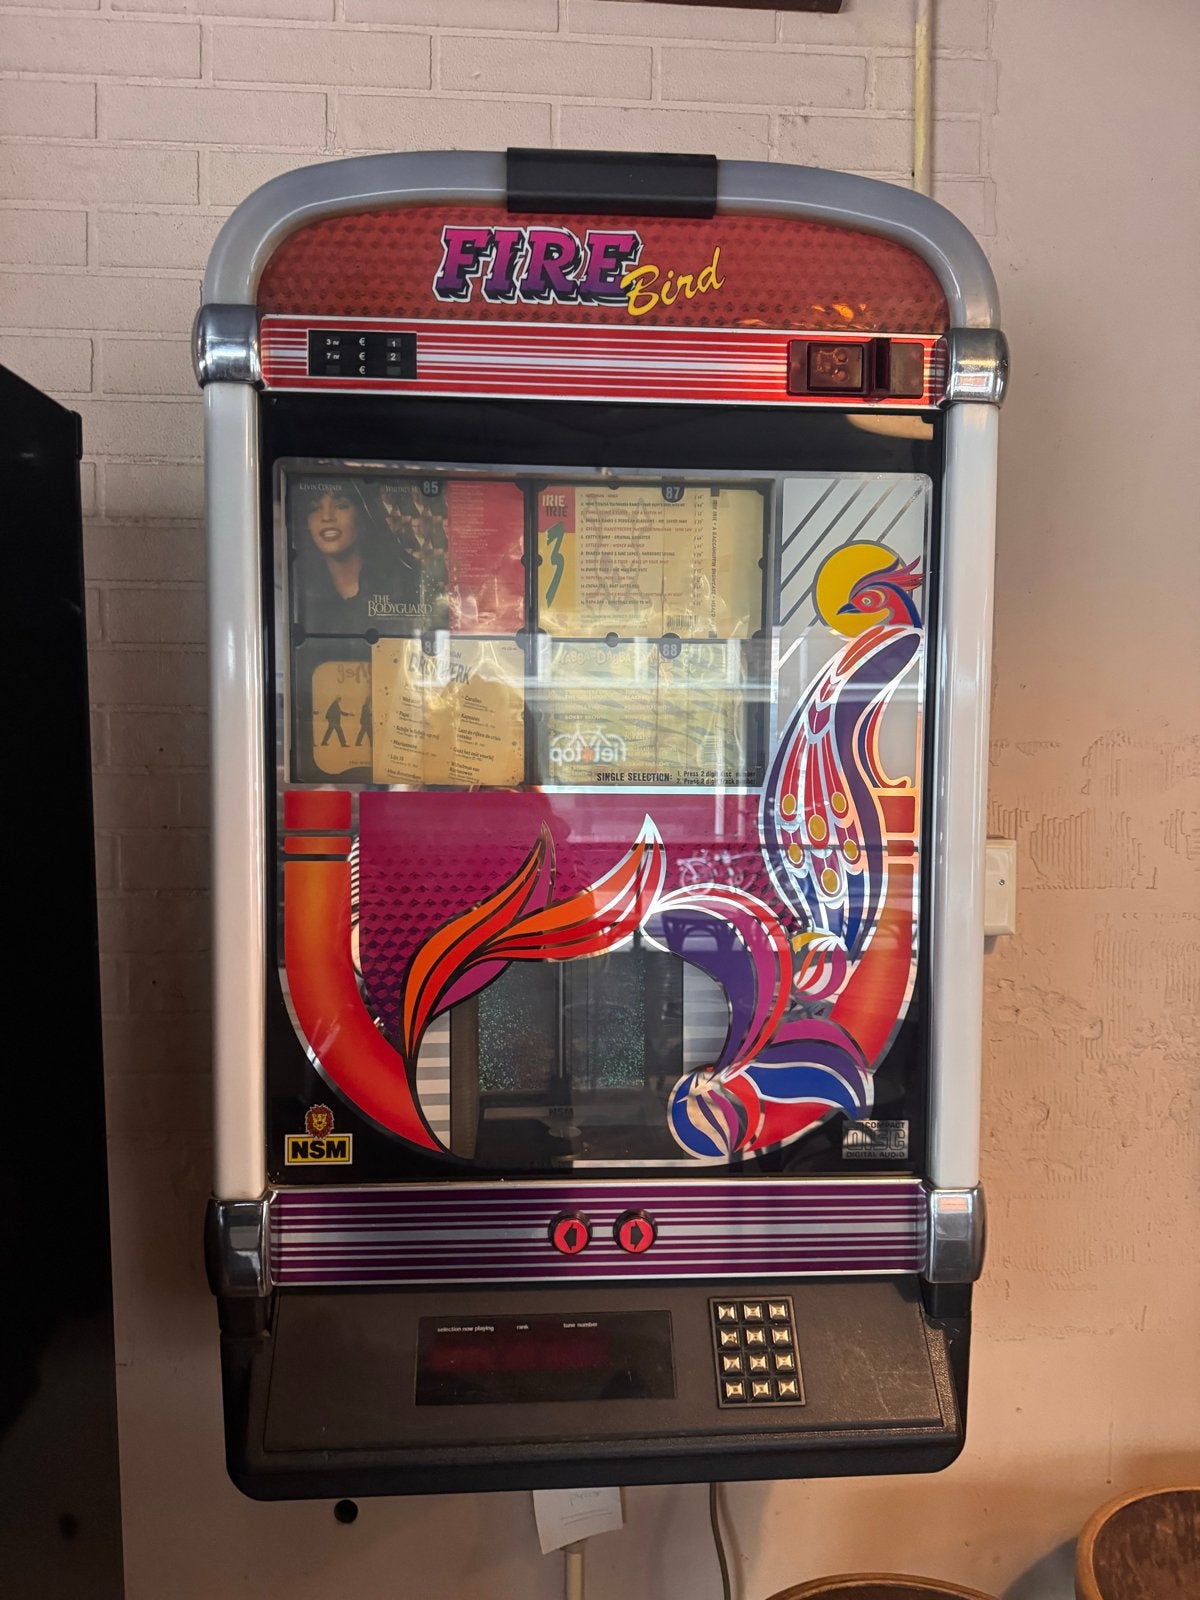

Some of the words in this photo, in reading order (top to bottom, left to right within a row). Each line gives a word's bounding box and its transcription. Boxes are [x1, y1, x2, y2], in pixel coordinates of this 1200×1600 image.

[433, 225, 642, 306] FIRE
[620, 247, 726, 316] Bird
[359, 338, 365, 346] €
[359, 352, 365, 360] €
[359, 366, 365, 374] €
[423, 481, 439, 494] 85
[665, 486, 681, 500] 87
[542, 494, 565, 507] IRIE
[546, 506, 568, 518] IRIE
[373, 594, 391, 604] THE
[368, 600, 433, 617] BODYGUARD
[662, 643, 678, 657] 88
[597, 772, 625, 782] SINGLE
[627, 772, 673, 782] SELECTION:
[291, 1140, 347, 1159] NSM
[474, 1325, 494, 1333] playing
